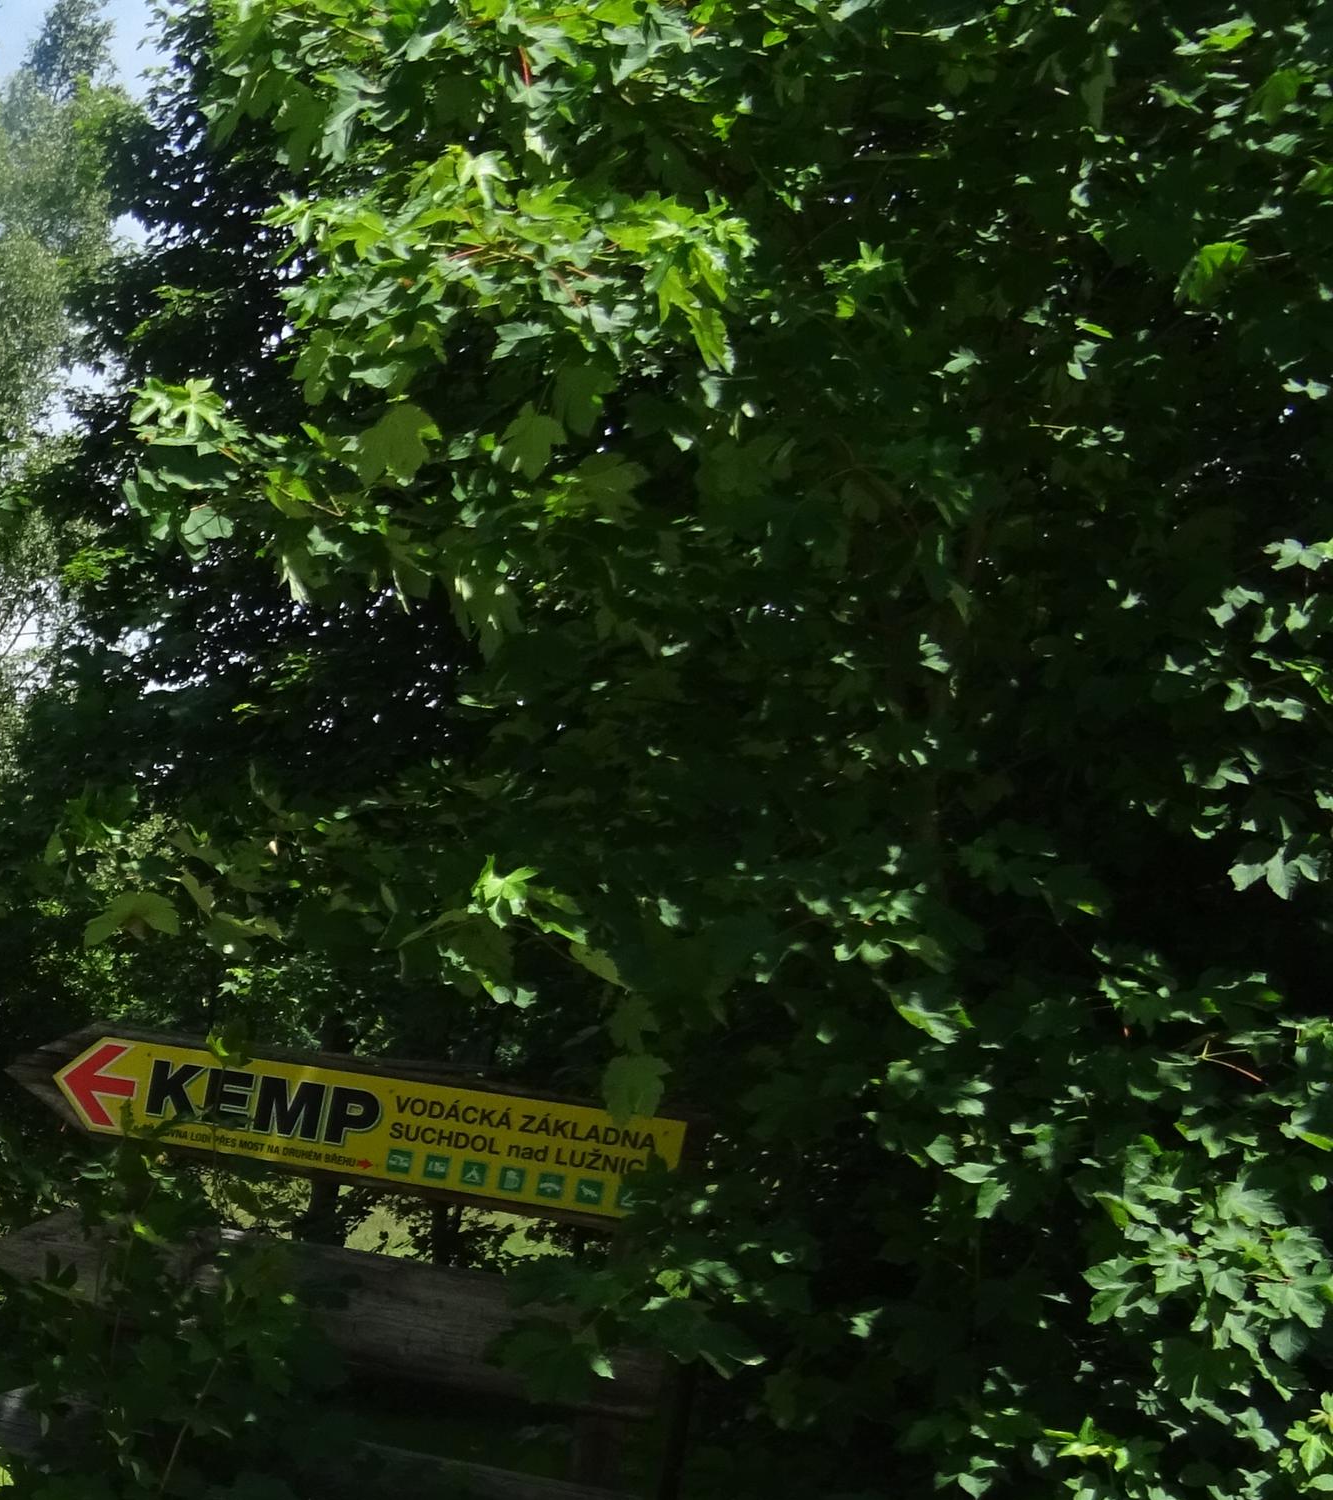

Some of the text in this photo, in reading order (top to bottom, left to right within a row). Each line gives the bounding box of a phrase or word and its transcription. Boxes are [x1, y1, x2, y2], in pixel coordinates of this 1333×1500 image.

[144, 1058, 382, 1146] KEMP
[395, 1095, 657, 1153] VODÁCKÁ ZÁKLADNA
[238, 1140, 266, 1152] MOST
[267, 1145, 280, 1155] NA
[389, 1122, 645, 1174] SUCHDOL nad LUŽNIC
